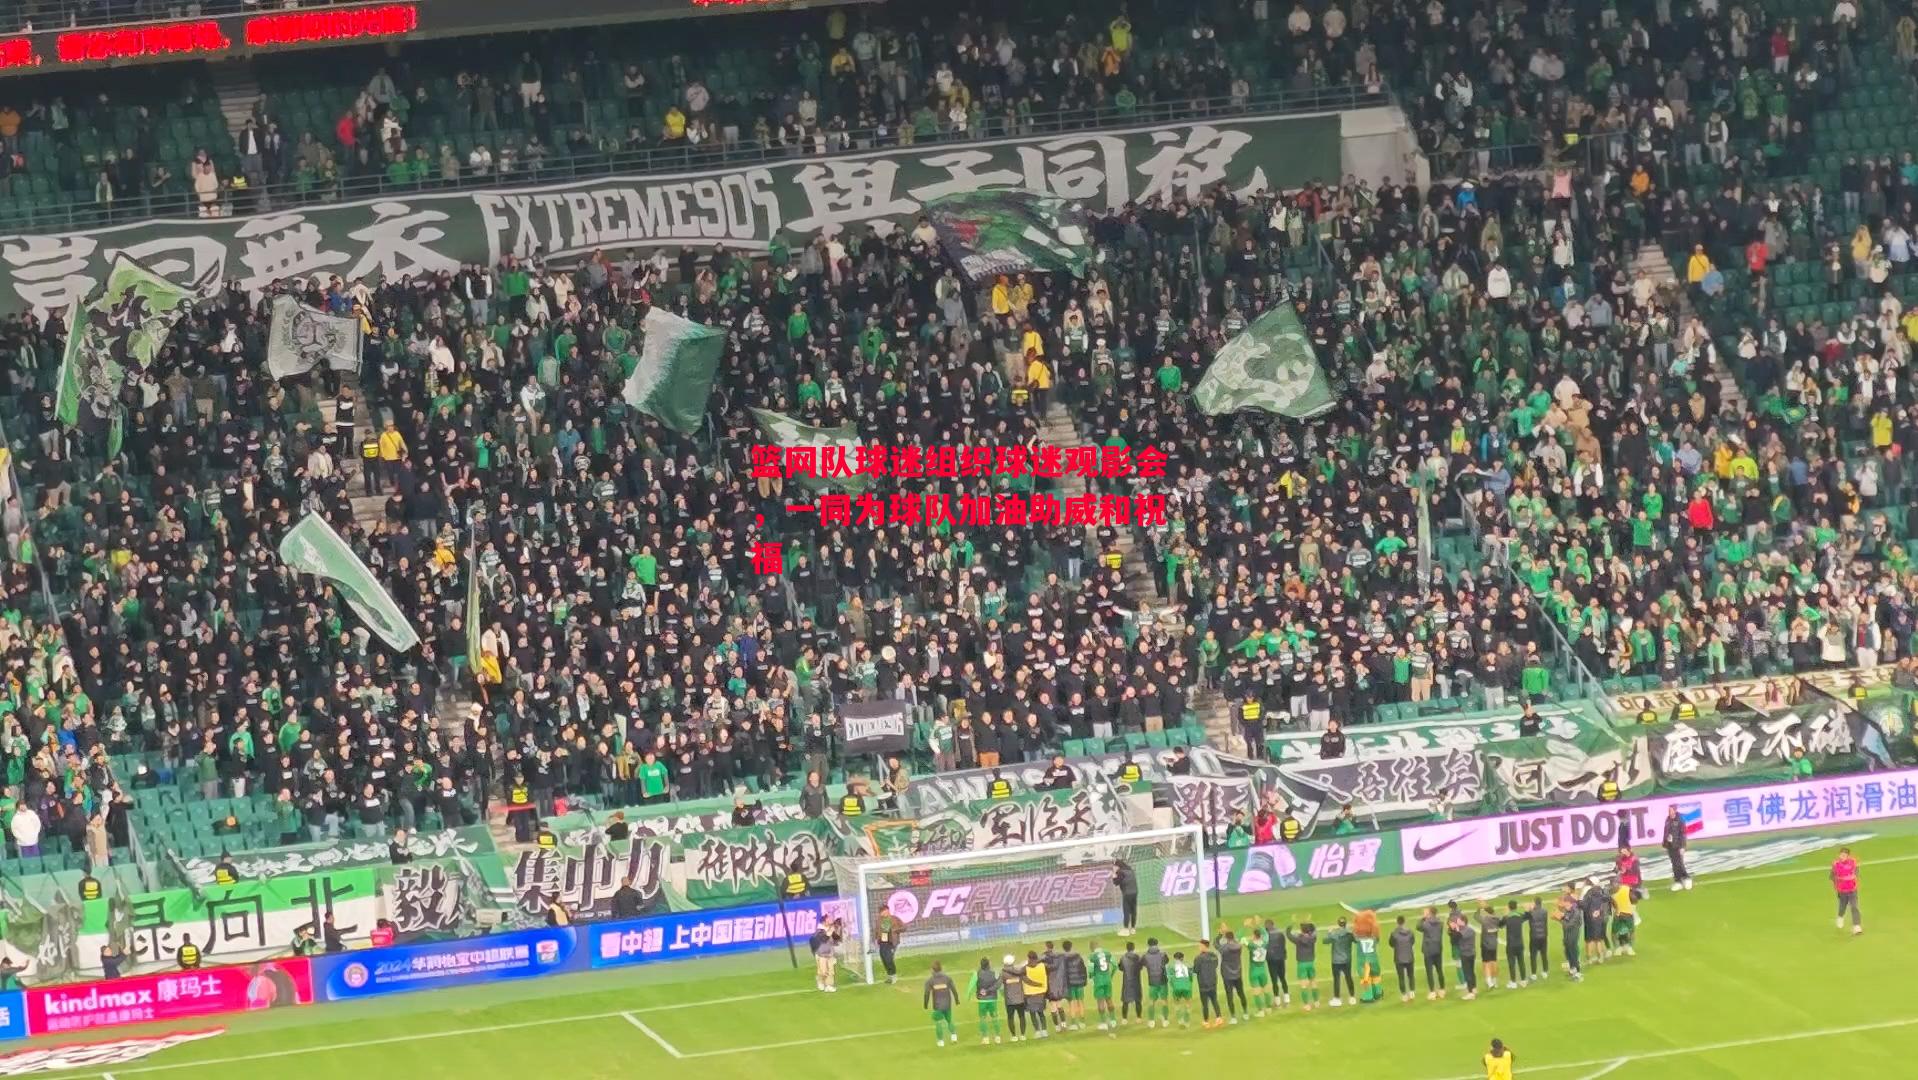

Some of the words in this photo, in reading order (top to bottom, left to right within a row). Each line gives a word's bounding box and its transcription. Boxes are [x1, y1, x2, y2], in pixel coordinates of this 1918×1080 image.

[1723, 777, 1918, 828] 雪佛龙润滑油
[1495, 814, 1564, 856] JUST
[1571, 809, 1617, 847] DO
[921, 885, 971, 919] FC
[44, 988, 153, 1015] kindmax
